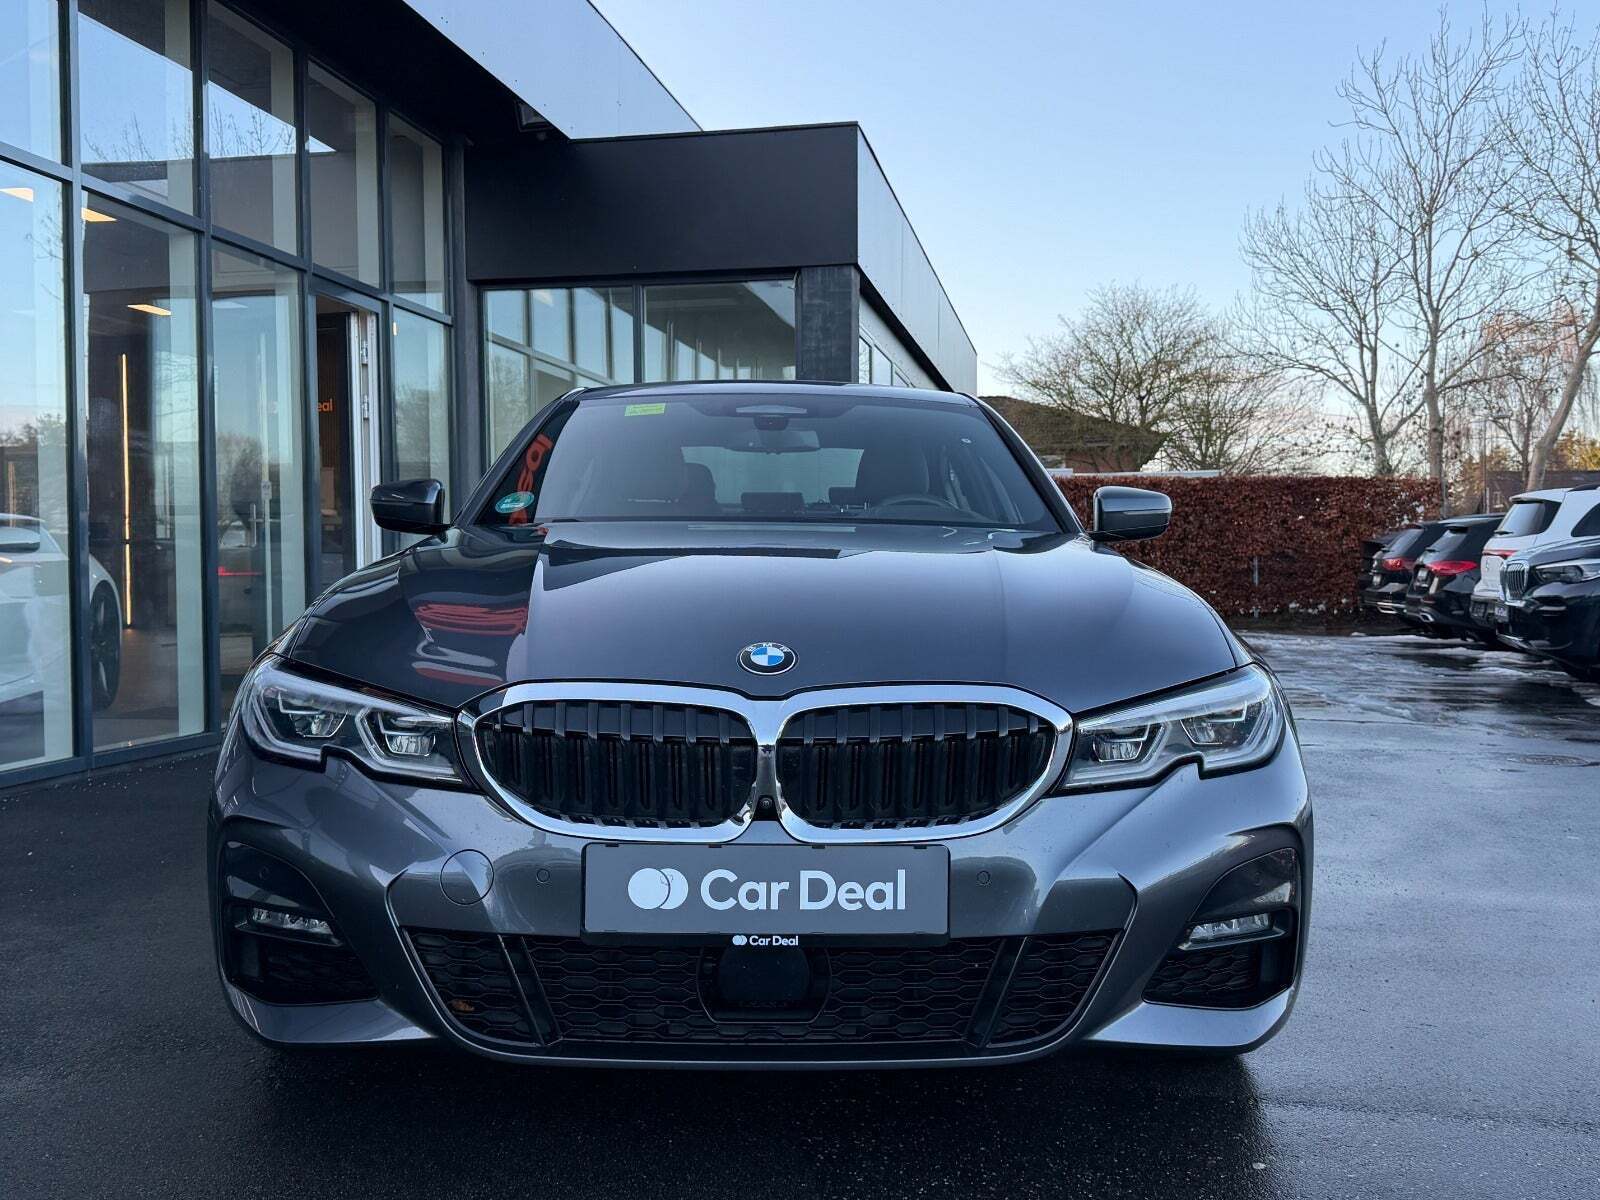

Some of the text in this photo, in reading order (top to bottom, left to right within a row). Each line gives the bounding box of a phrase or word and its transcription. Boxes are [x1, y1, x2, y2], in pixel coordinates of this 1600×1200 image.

[700, 868, 906, 911] Car Deal
[749, 935, 799, 946] Car Deal
